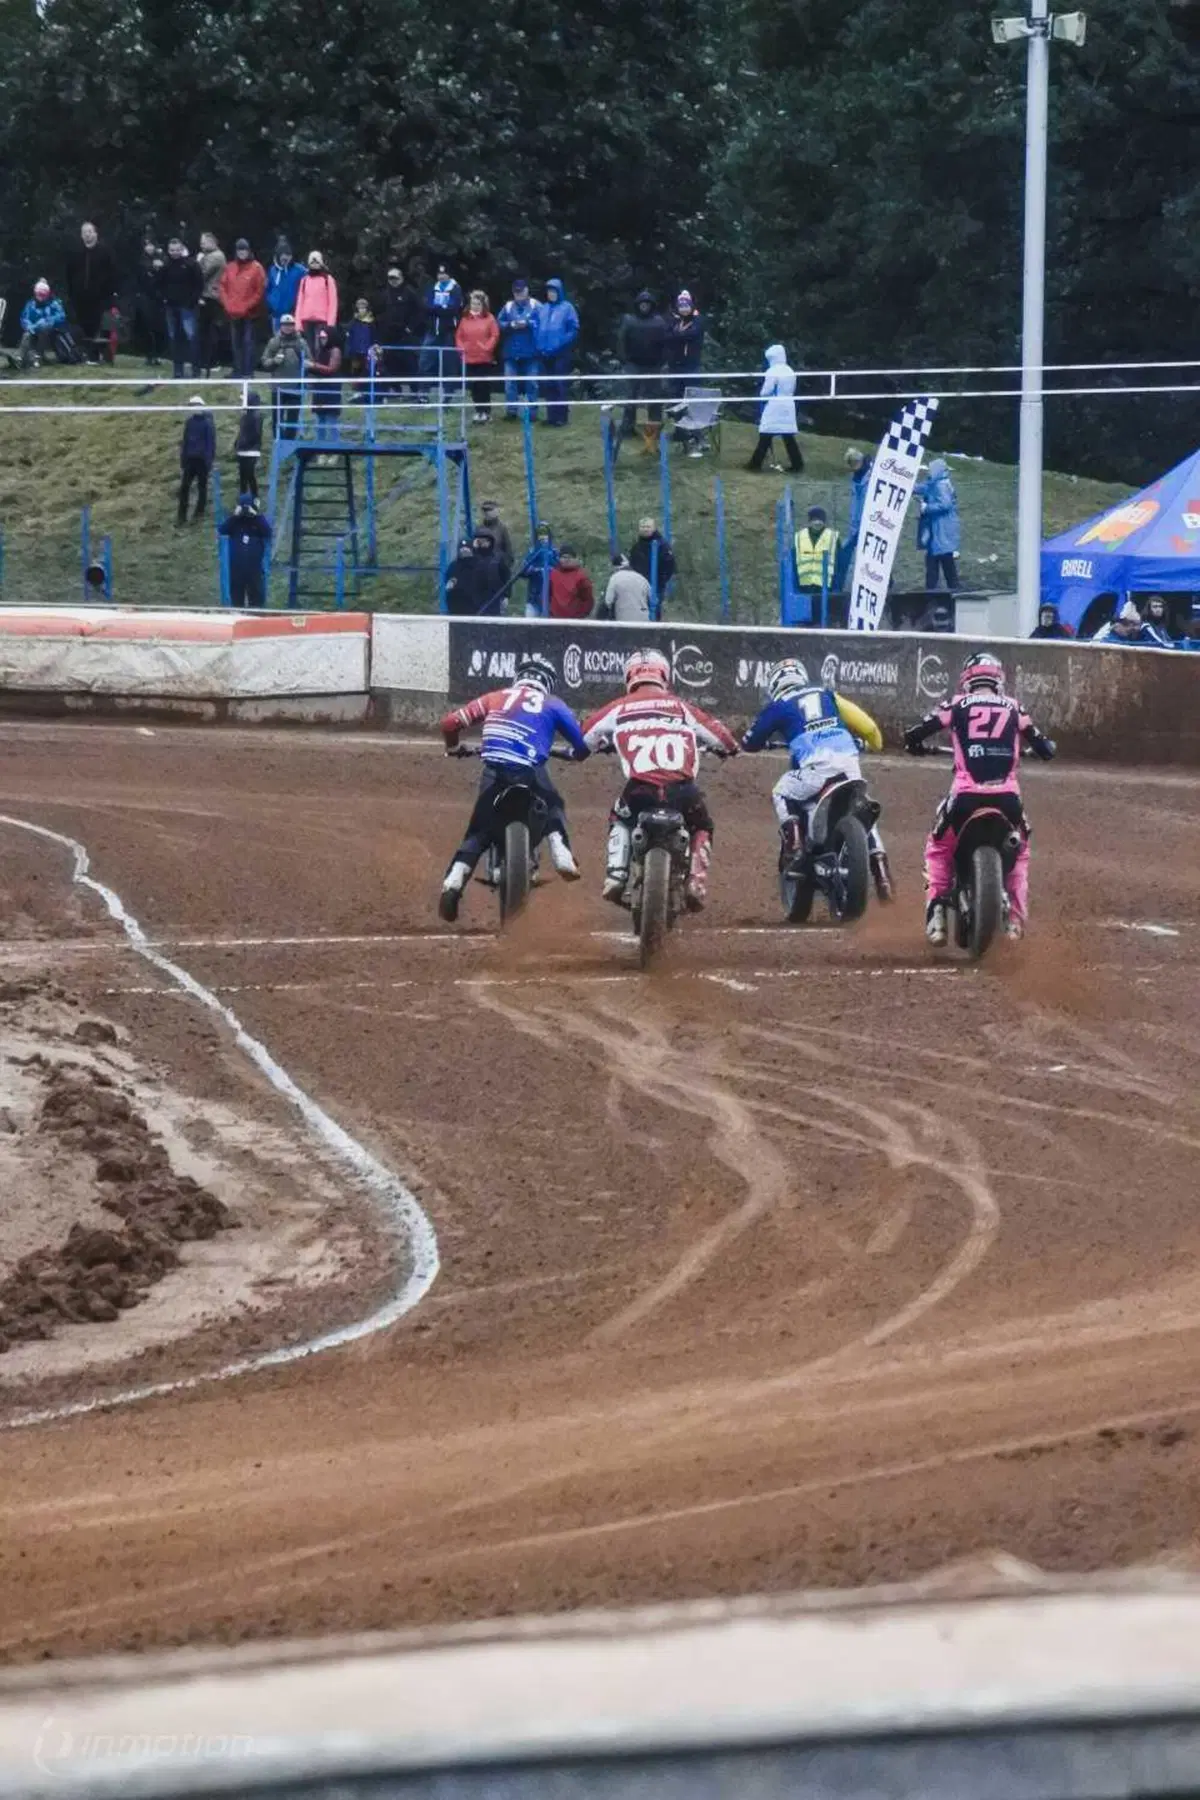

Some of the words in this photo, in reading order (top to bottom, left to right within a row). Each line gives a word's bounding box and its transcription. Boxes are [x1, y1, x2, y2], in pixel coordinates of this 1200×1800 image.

[880, 458, 914, 478] Indian
[873, 479, 907, 512] FTR
[863, 531, 888, 564] FTR
[856, 584, 878, 617] FTR
[584, 651, 626, 672] KOOPM
[501, 687, 545, 714] 73
[798, 692, 823, 722] 1
[968, 706, 1010, 739] 27
[627, 734, 685, 774] 70
